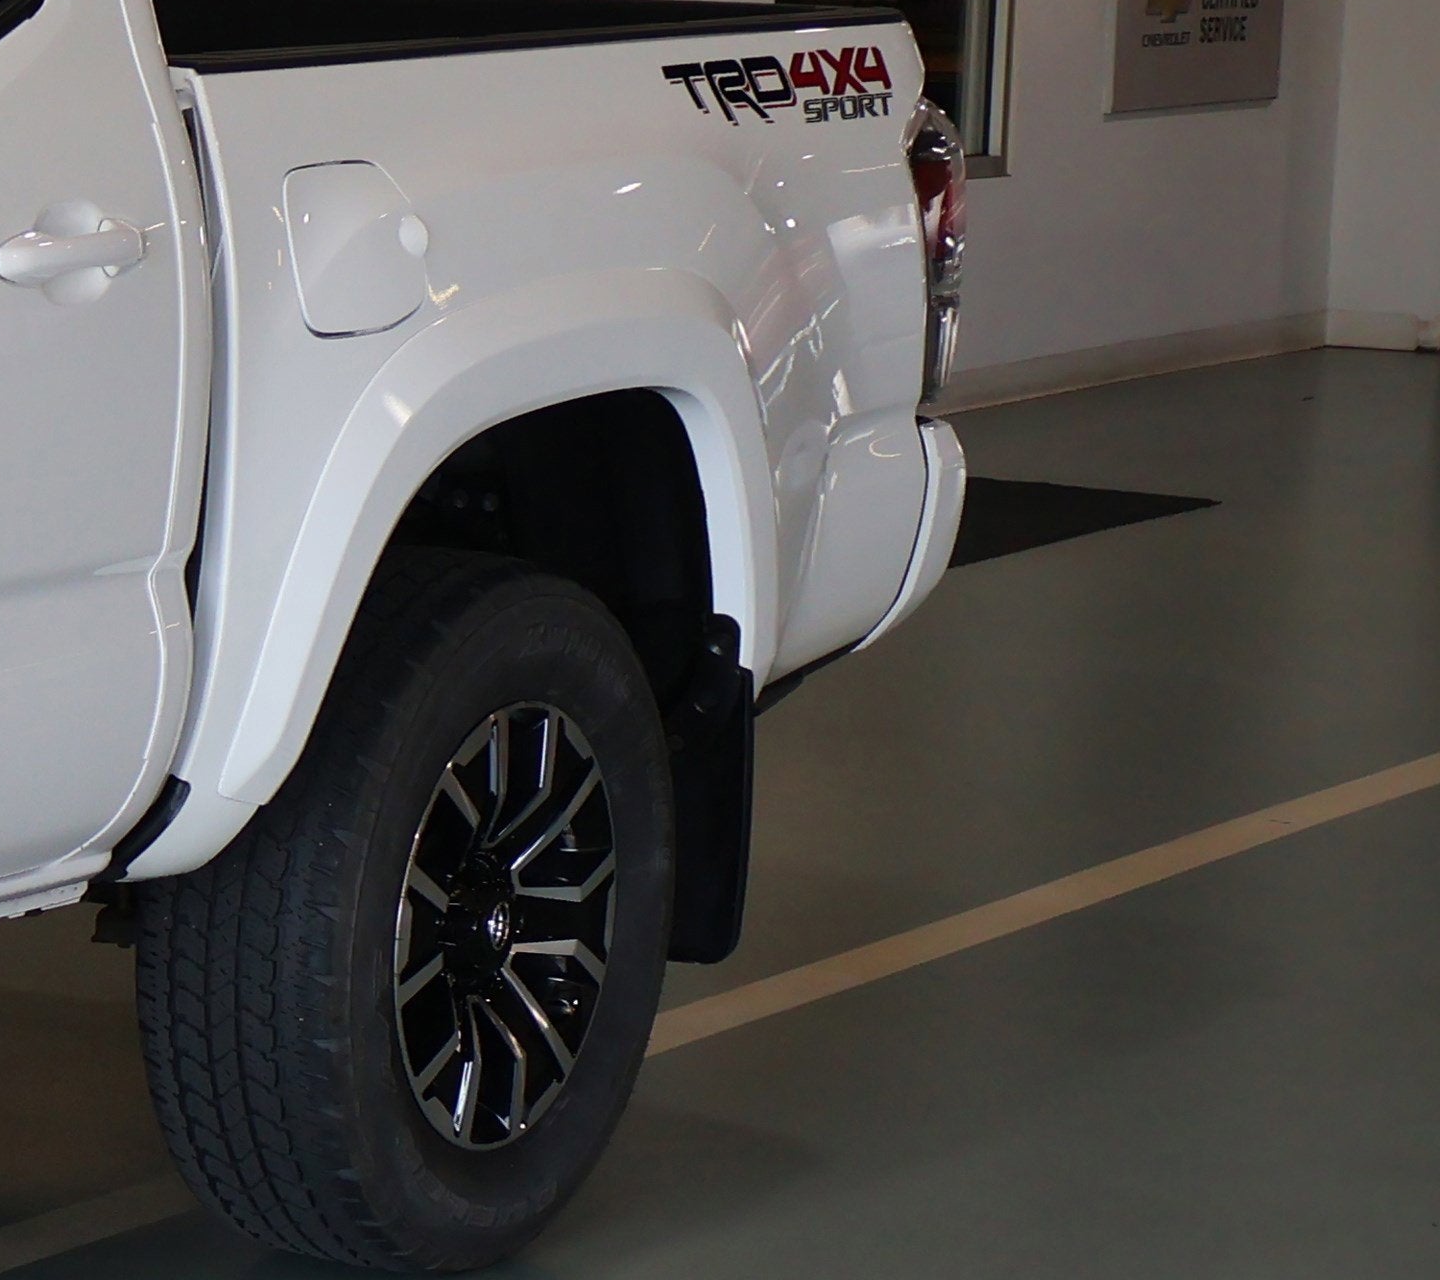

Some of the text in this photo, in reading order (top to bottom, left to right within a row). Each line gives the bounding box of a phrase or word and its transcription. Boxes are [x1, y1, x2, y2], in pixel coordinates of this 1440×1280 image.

[1199, 16, 1248, 44] SERVICE
[661, 55, 798, 127] TRD
[803, 92, 893, 124] SPORT
